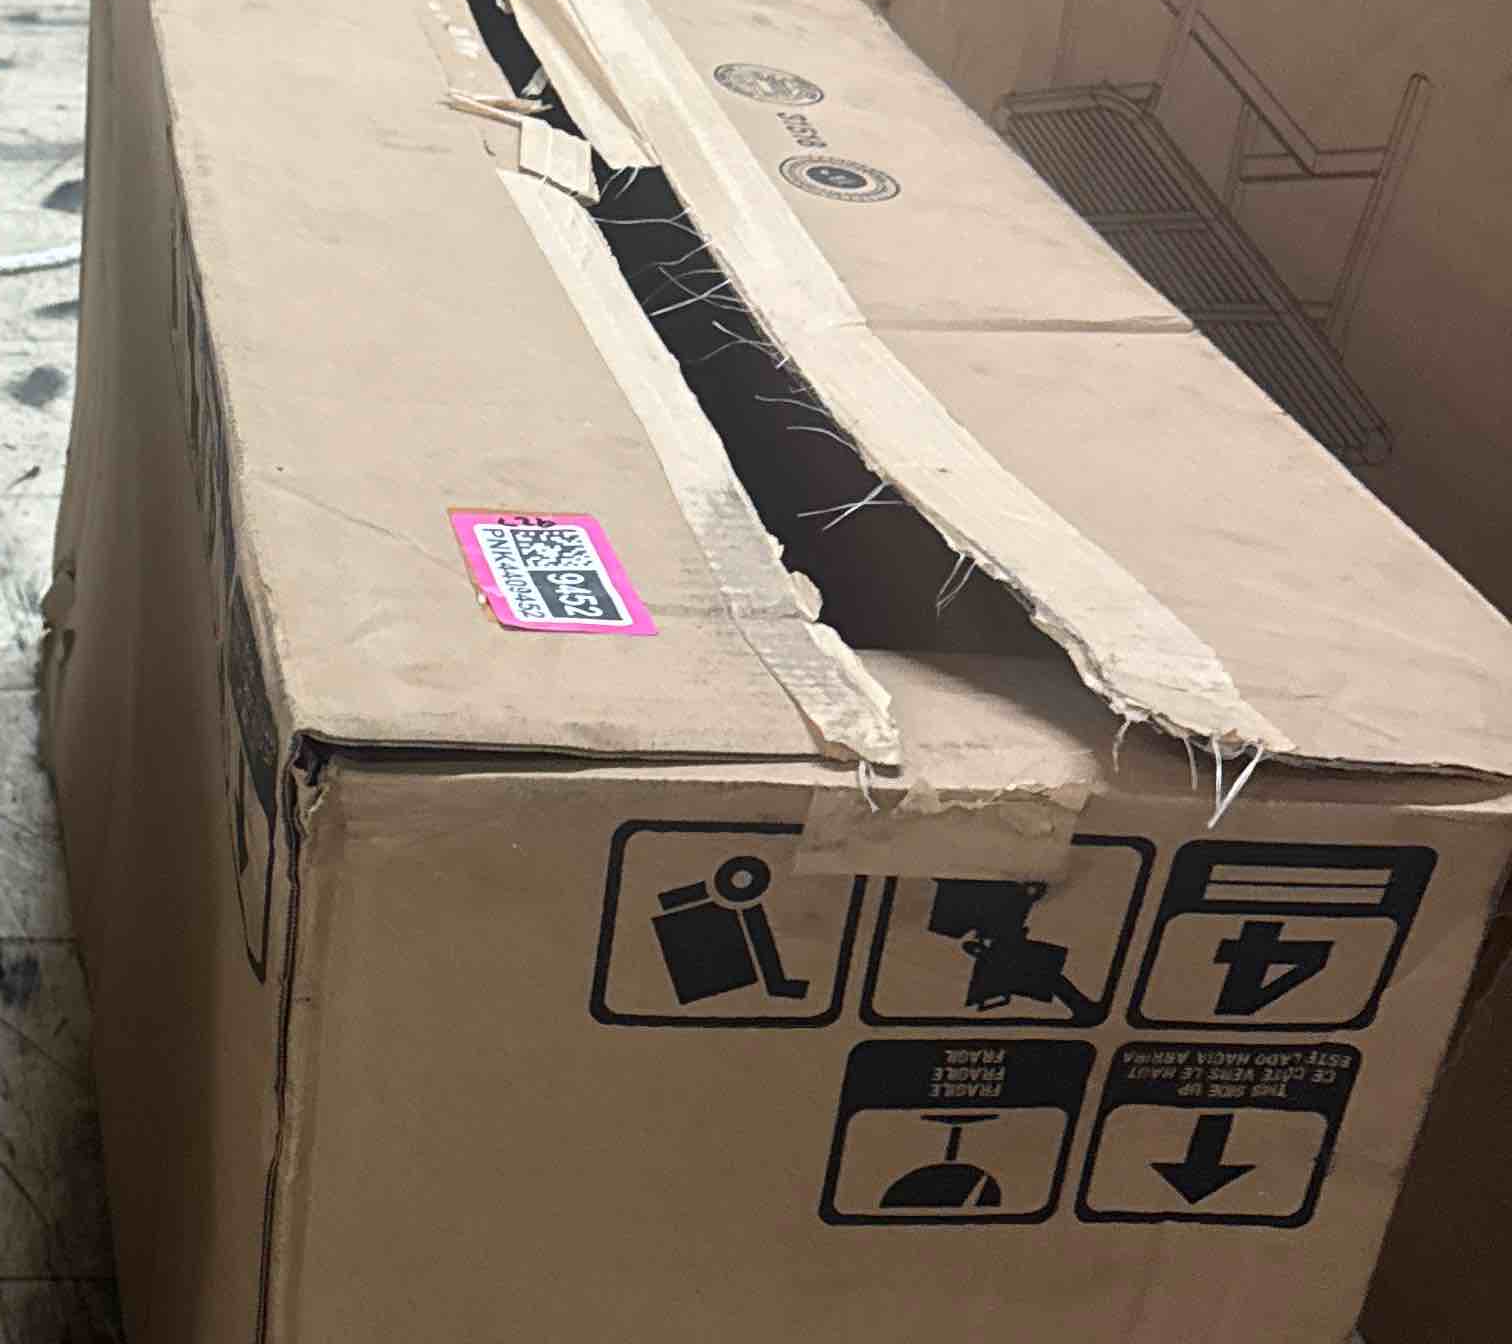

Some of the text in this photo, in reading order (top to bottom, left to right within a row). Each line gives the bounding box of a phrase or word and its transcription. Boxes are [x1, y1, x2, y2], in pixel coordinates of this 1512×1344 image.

[482, 527, 546, 620] PNK4409452
[547, 572, 604, 618] 9452
[1213, 920, 1335, 1016] 4
